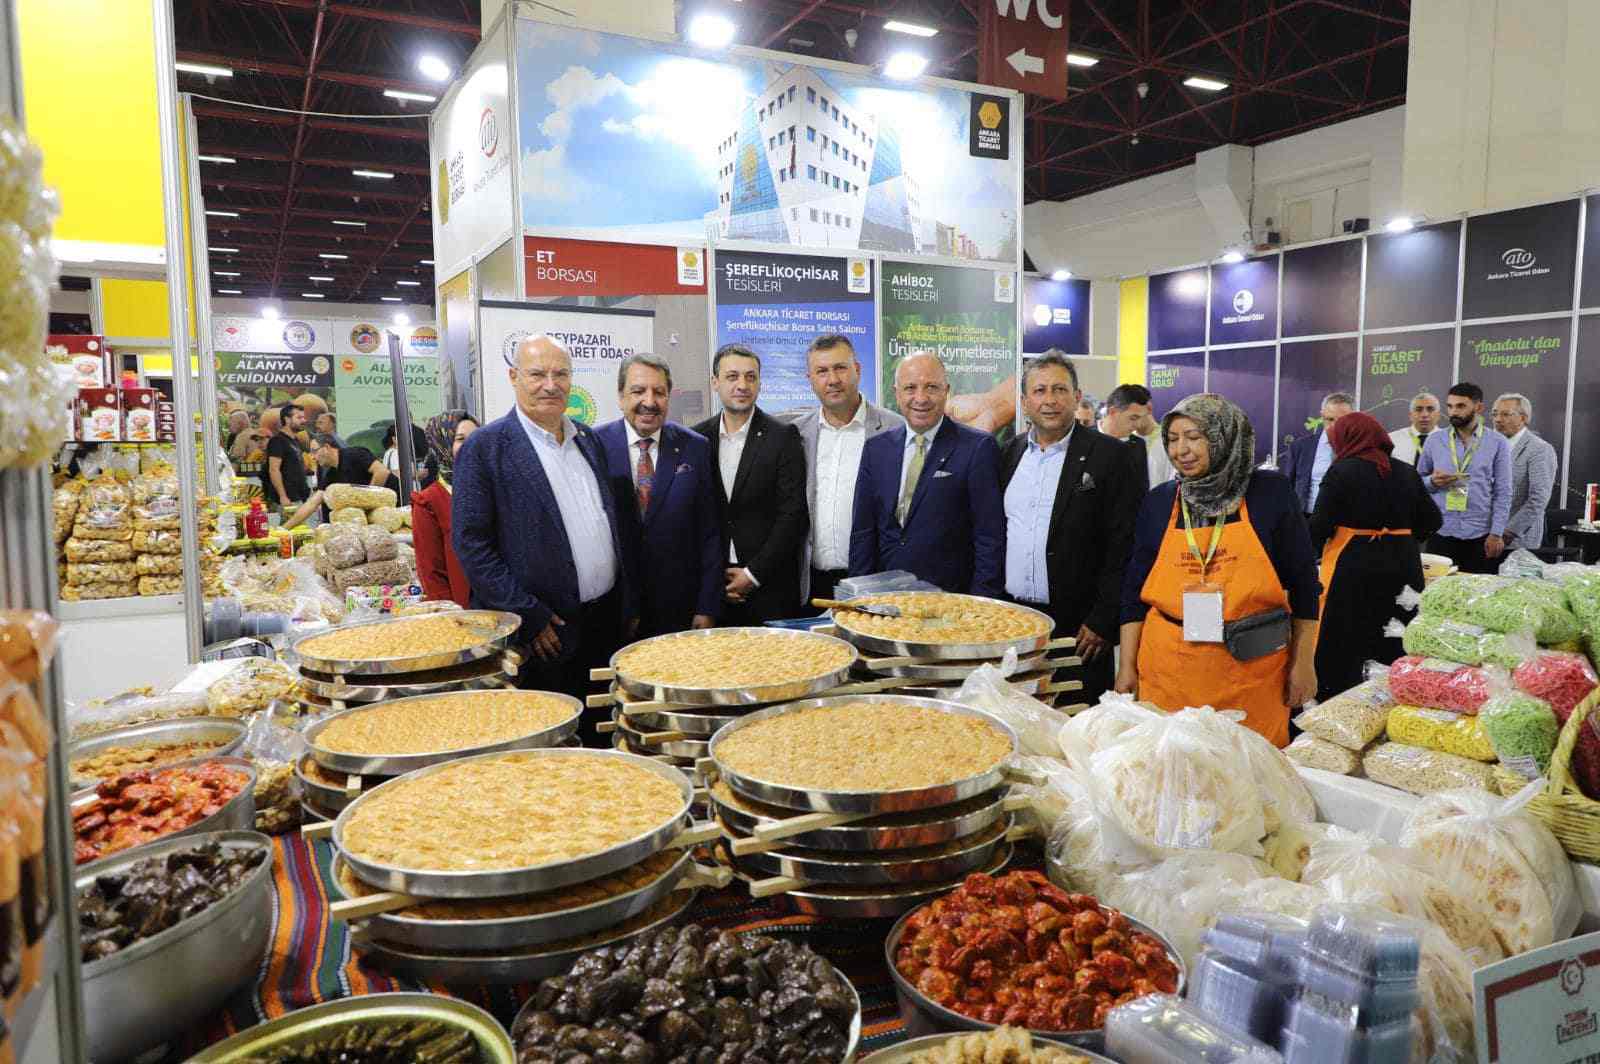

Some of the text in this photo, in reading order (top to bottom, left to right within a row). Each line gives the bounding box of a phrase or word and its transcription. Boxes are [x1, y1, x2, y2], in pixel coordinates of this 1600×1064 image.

[994, 0, 1063, 29] WC
[536, 250, 555, 263] ET
[536, 267, 597, 283] BORSASI
[726, 262, 839, 282] ŞEREFLİKOÇHİSAR
[727, 278, 782, 293] TESİSLERİ
[891, 272, 934, 288] AHİBOZ
[743, 307, 779, 319] ANKARA
[815, 310, 850, 321] BORSASI
[791, 322, 816, 332] Borsa
[838, 325, 867, 335] Salonu
[235, 360, 295, 371] ALANYA
[218, 371, 319, 385] YENİDÜNYASI
